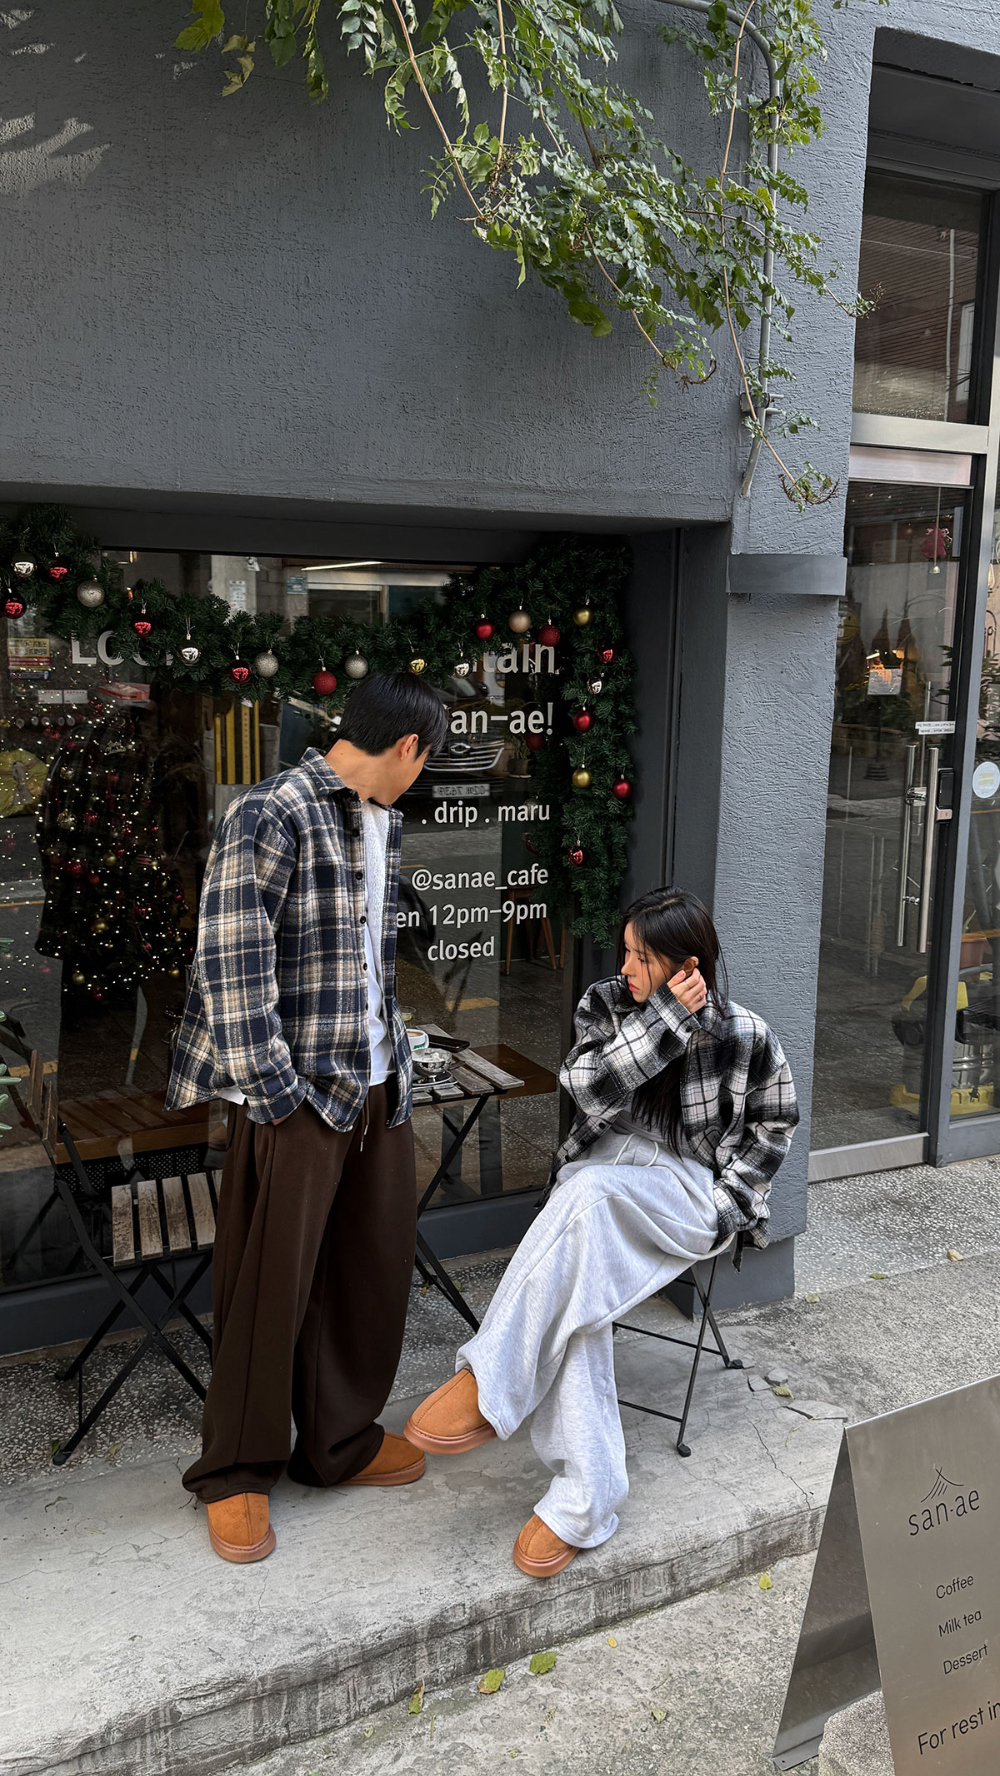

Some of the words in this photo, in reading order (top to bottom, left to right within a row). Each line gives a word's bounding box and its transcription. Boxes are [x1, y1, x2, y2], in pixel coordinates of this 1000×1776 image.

[442, 701, 555, 736] an-ae!
[434, 800, 479, 828] drip
[497, 804, 551, 822] maru
[411, 863, 550, 891] @sanae_cafe
[396, 909, 421, 928] en
[429, 900, 548, 929] 12pm-9pm
[427, 936, 495, 962] closed
[936, 1575, 974, 1599] Coffee
[938, 1617, 962, 1638] Milk
[963, 1609, 982, 1626] tea
[943, 1643, 988, 1675] Dessert
[918, 1731, 947, 1755] For
[951, 1706, 984, 1739] rest
